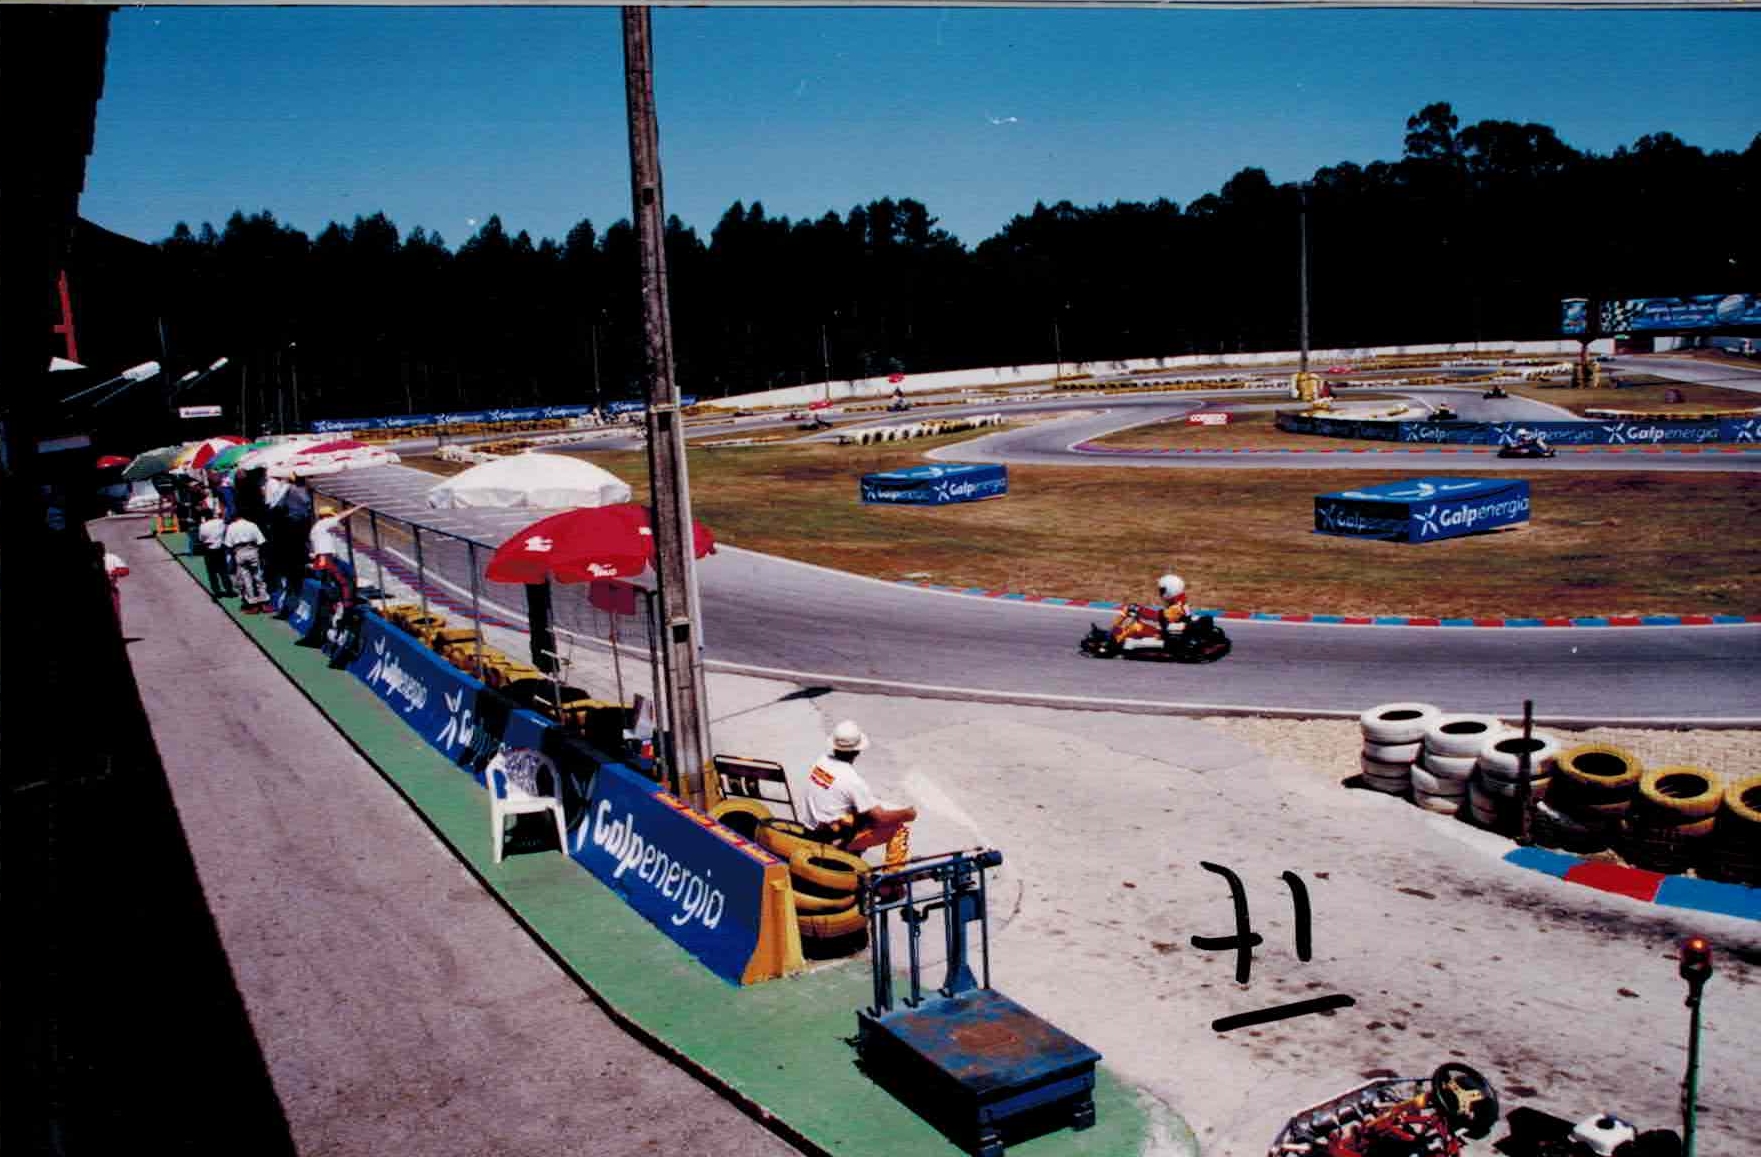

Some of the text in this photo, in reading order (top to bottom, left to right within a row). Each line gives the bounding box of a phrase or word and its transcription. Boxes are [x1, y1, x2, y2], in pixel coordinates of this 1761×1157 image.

[1627, 425, 1720, 442] Galpenergia
[1440, 494, 1530, 527] Galpenergia
[594, 799, 725, 929] Galpenergia
